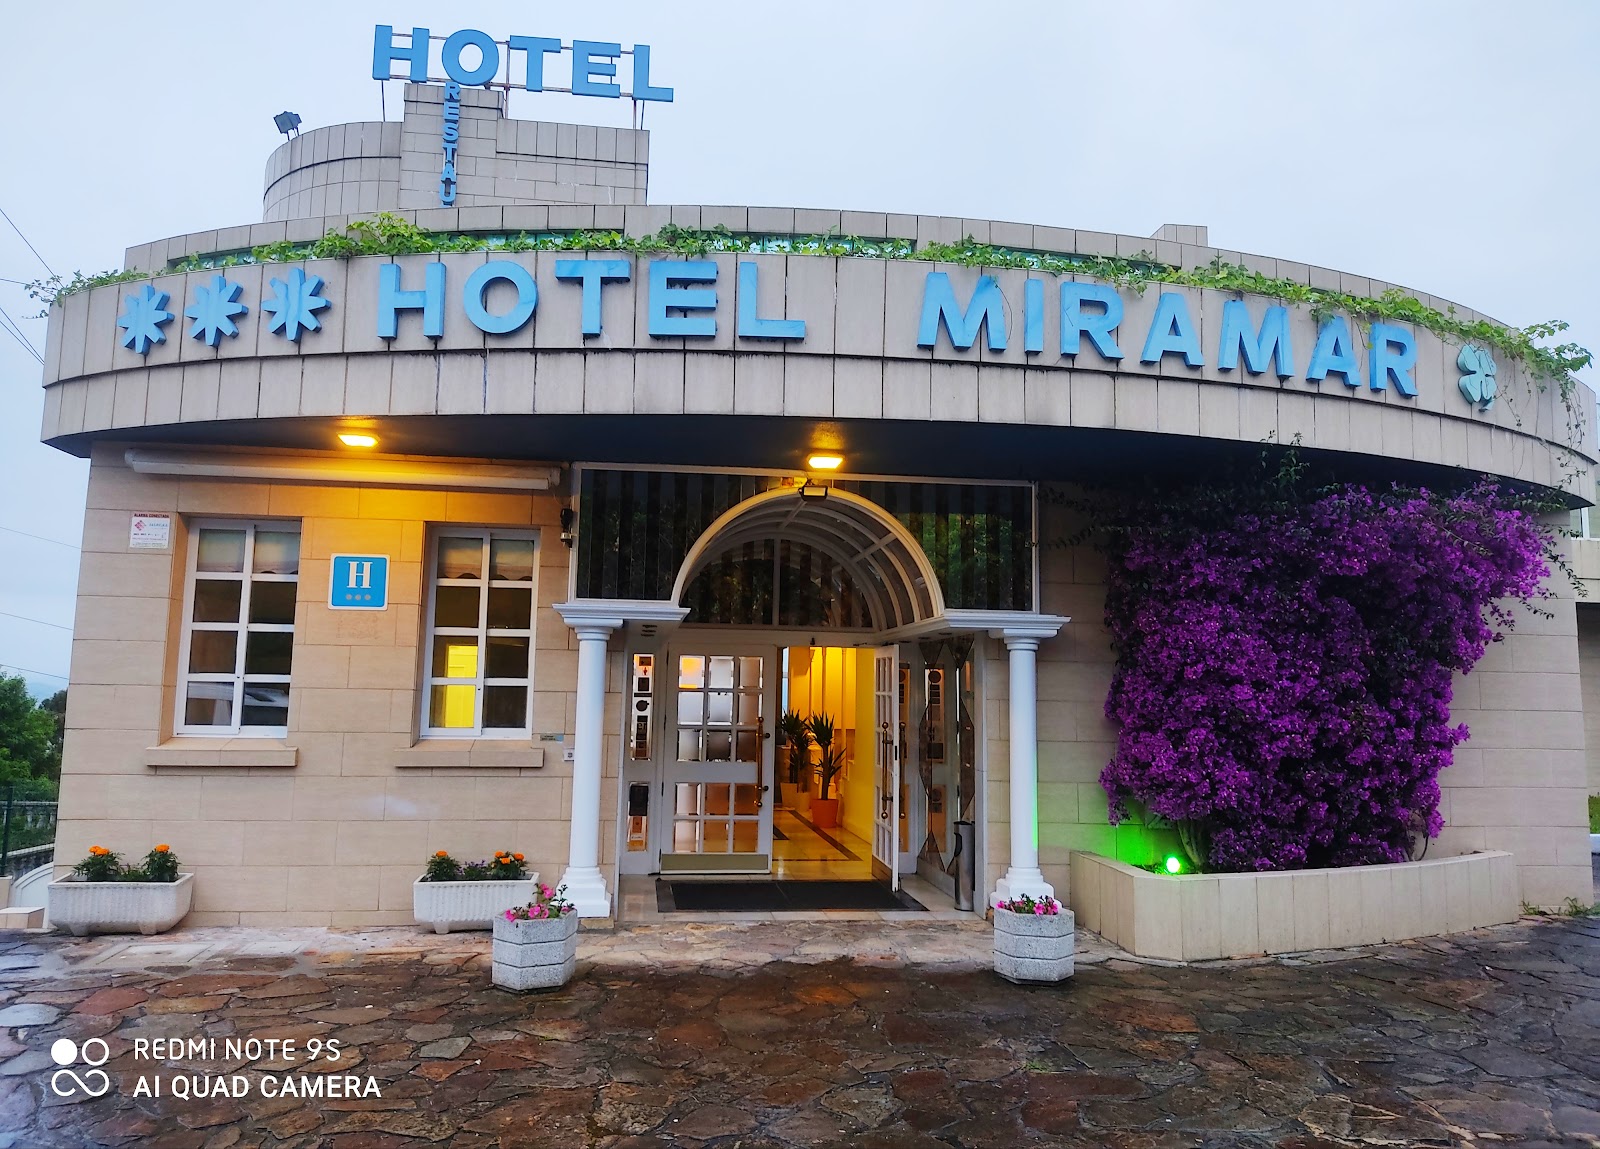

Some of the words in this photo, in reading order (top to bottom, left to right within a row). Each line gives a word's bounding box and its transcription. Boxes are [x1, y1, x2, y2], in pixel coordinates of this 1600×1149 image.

[372, 24, 674, 103] HOTEL
[440, 81, 461, 207] RESTAU
[377, 259, 806, 339] HOTEL
[917, 271, 1419, 398] MIRAMAR
[347, 562, 373, 588] H
